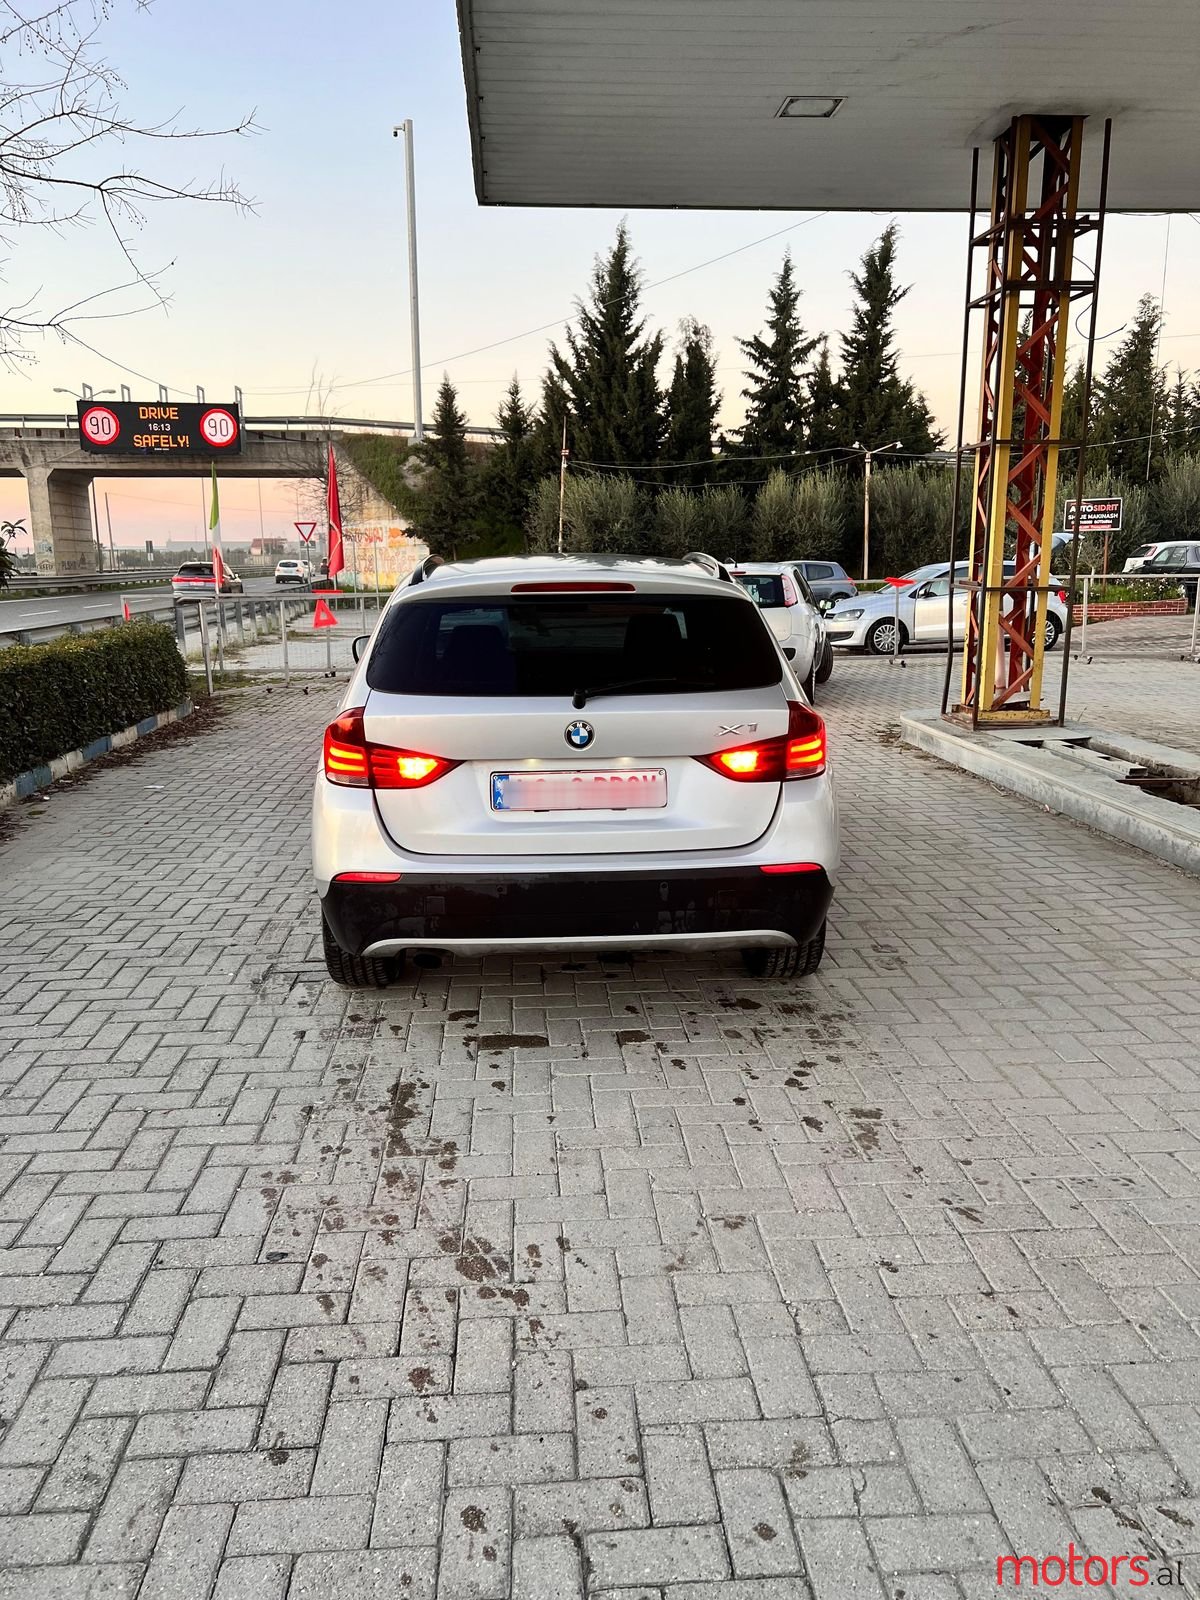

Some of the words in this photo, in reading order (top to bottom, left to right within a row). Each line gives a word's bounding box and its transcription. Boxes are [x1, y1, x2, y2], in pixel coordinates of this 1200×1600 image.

[139, 406, 179, 420] DRIVE
[89, 416, 111, 435] 90
[148, 423, 171, 431] 16:13
[208, 418, 229, 437] 90
[133, 434, 190, 448] SAFELY!
[567, 722, 592, 731] BMW
[718, 723, 757, 736] X1
